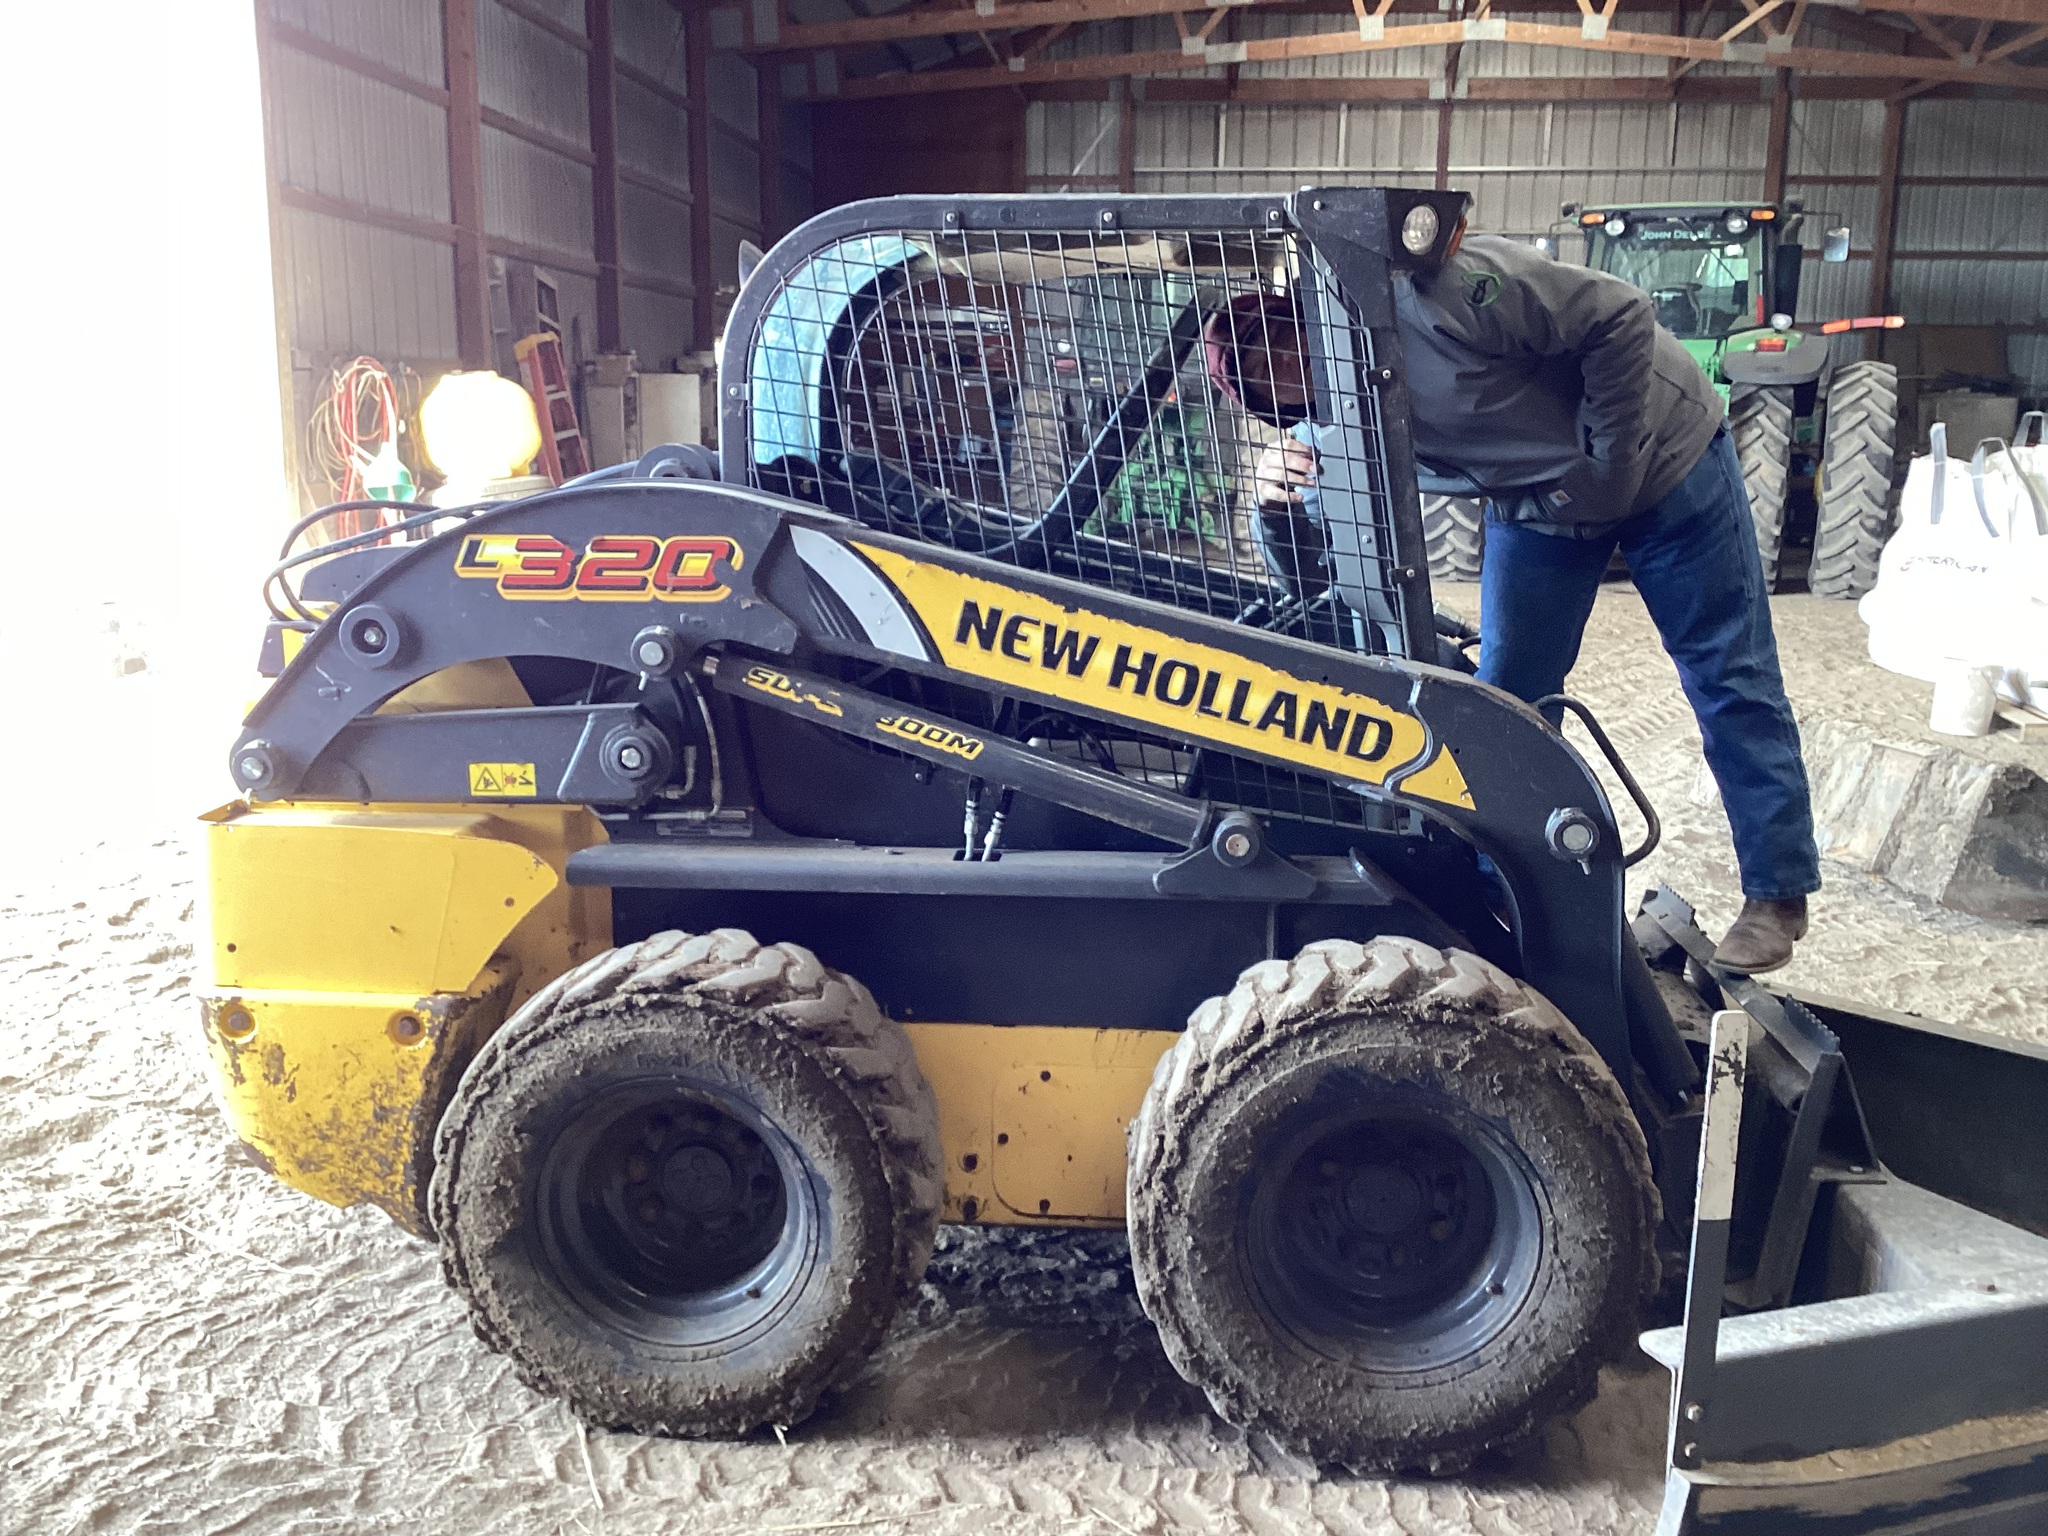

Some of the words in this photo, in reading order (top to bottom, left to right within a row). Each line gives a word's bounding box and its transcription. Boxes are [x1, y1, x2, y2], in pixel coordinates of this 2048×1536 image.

[1640, 230, 1672, 241] JOHN
[454, 534, 744, 602] L320
[953, 598, 1100, 678] NEW
[1105, 643, 1395, 763] HOLLAND
